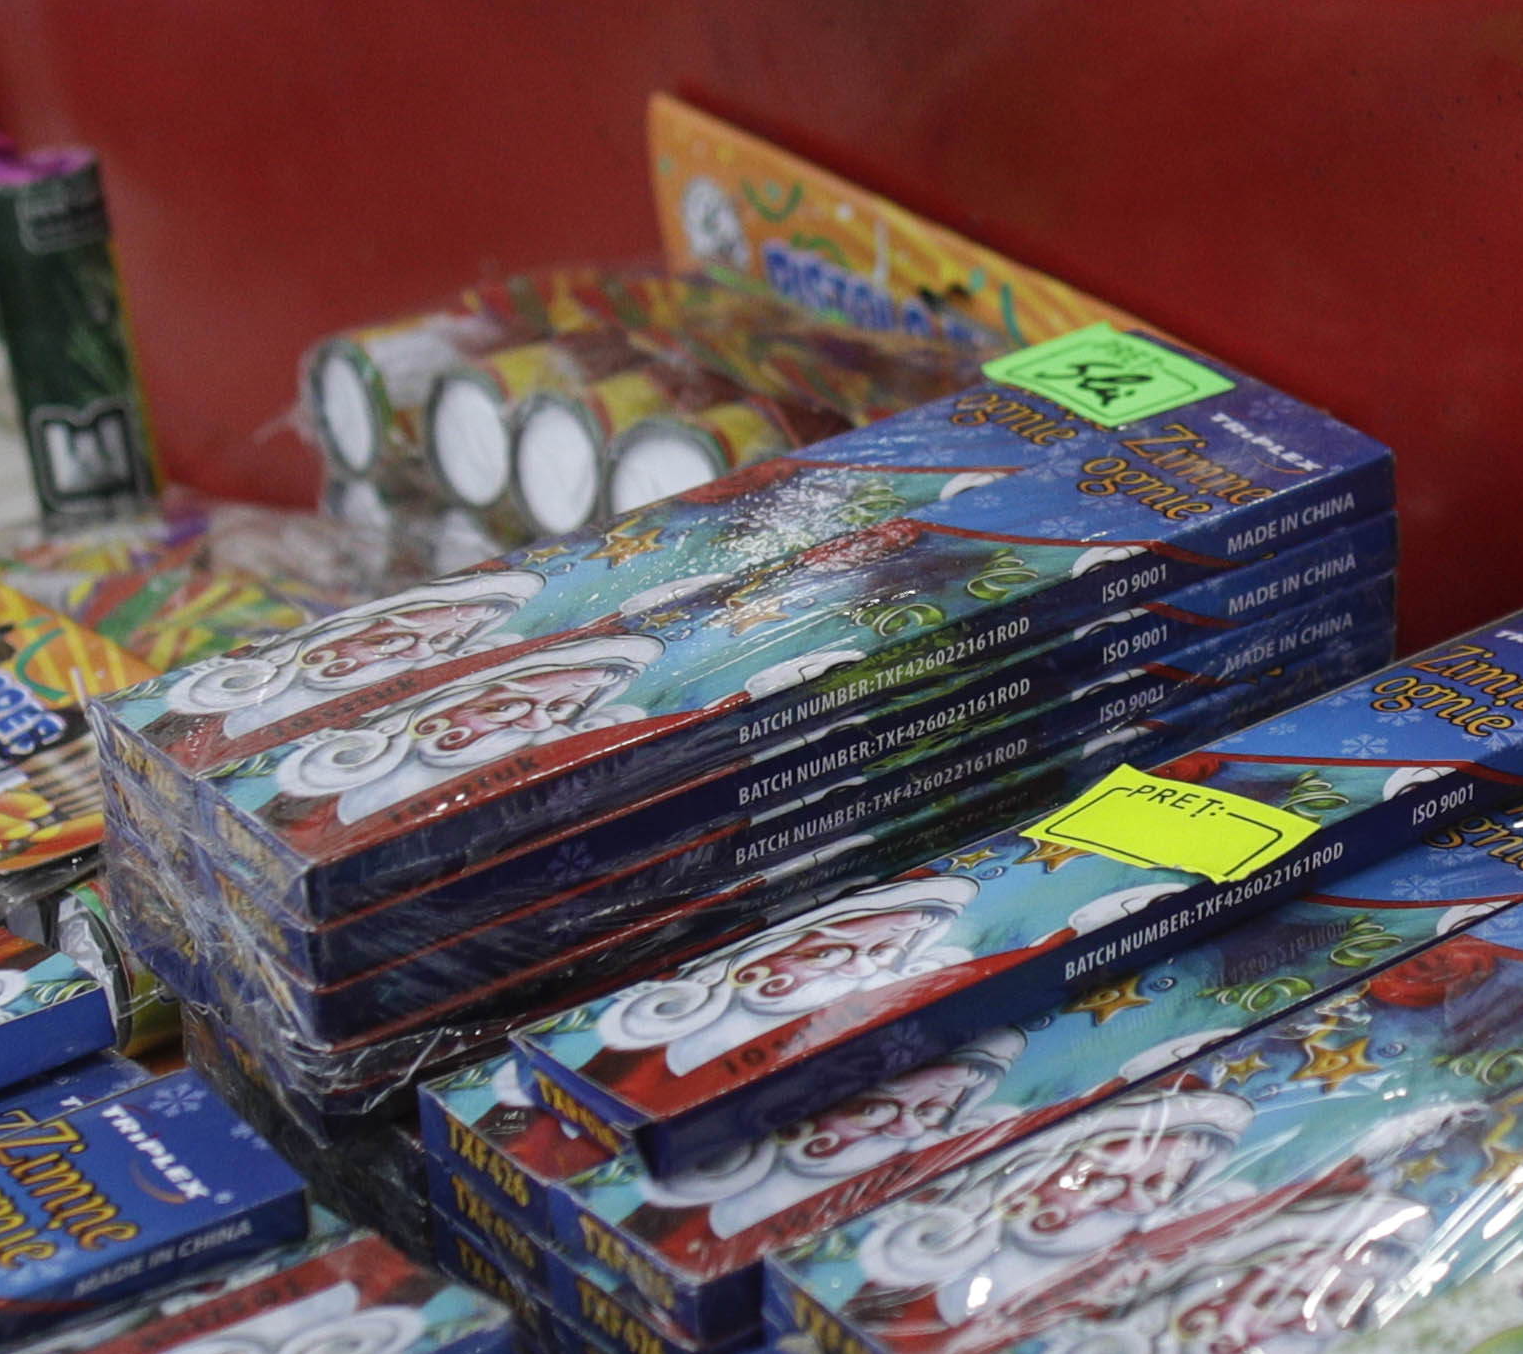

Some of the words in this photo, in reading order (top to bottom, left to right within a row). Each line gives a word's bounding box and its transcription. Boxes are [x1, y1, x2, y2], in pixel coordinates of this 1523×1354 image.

[1078, 456, 1213, 522] ognie
[1123, 424, 1275, 505] Zimne
[1227, 521, 1276, 555] MADE
[1280, 513, 1299, 540] IN
[1303, 492, 1356, 532] CHINA
[1102, 578, 1128, 602] ISO
[1132, 565, 1168, 596] 9001
[1227, 582, 1276, 616] MADE
[1280, 574, 1299, 601] IN
[1303, 553, 1356, 593] CHINA
[1103, 640, 1128, 664] ISO
[1132, 626, 1168, 657] 9001
[1225, 643, 1276, 674] MADE
[1278, 635, 1296, 662] IN
[1300, 613, 1353, 653] CHINA
[739, 708, 791, 744] BATCH
[1099, 698, 1125, 723] ISO
[1128, 684, 1164, 714] 9001
[1372, 675, 1514, 737] ognie
[739, 771, 791, 805] BATCH
[1413, 802, 1436, 825] ISO
[1439, 784, 1474, 813] 9001
[736, 830, 789, 866] BATCH
[1065, 946, 1116, 981] BATCH
[447, 1113, 532, 1208] TXF426
[73, 1256, 141, 1297] MADE
[147, 1246, 171, 1270] IN
[179, 1220, 253, 1260] CHINA
